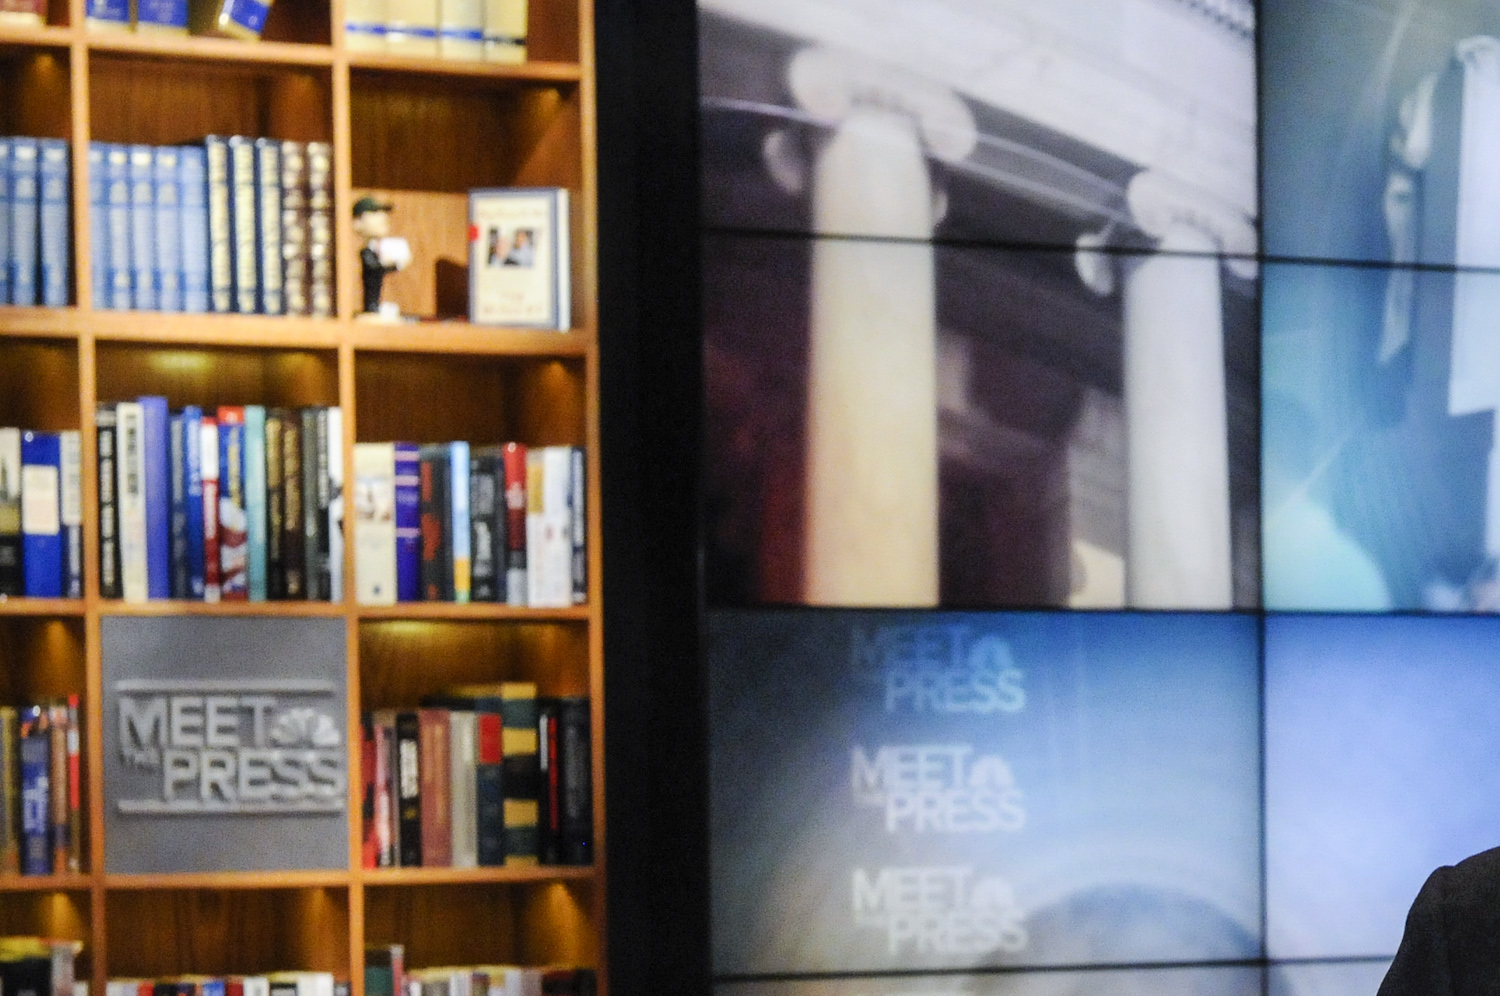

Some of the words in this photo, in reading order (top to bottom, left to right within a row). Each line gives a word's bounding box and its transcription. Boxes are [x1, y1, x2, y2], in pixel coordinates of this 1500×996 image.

[885, 668, 1026, 713] PRESS
[119, 697, 277, 753] MEET
[164, 750, 345, 802] PRESS
[851, 743, 974, 795] MEET
[885, 787, 1026, 834] PRESS
[851, 865, 972, 915] MEET
[888, 906, 1028, 956] PRESS
